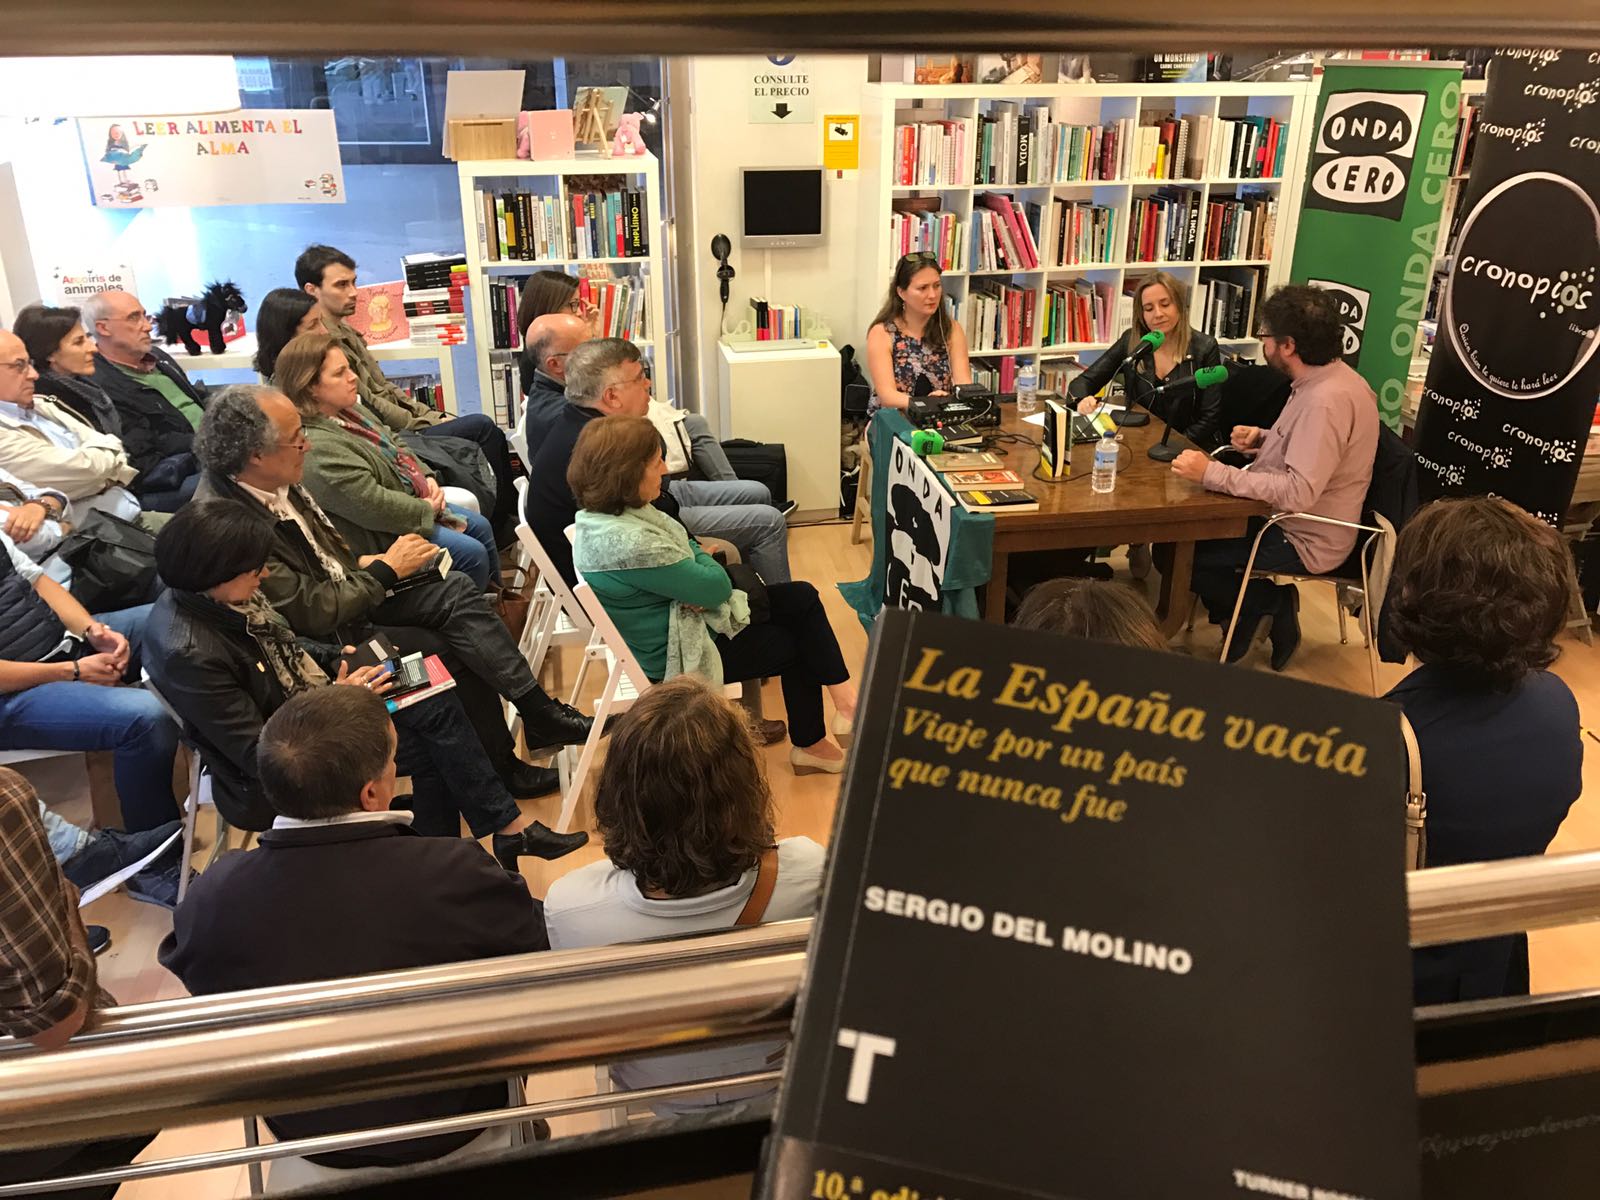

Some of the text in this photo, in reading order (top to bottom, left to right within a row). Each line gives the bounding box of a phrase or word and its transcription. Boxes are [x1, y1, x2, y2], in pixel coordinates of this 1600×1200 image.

[754, 75, 809, 84] CONSULTE
[754, 87, 810, 97] EL PRECIO
[1524, 82, 1599, 106] cronopios
[132, 119, 303, 136] LEER ALIMENTA EL
[1331, 116, 1403, 142] ONDA
[1421, 81, 1460, 205] CERO
[1480, 121, 1544, 144] cronopios
[197, 141, 250, 155] ALMA
[1018, 134, 1029, 167] MODA
[1326, 164, 1395, 195] CERO
[1188, 208, 1199, 245] EL INCAL
[64, 282, 124, 295] animales
[108, 274, 122, 282] de
[1390, 221, 1440, 356] ONDA
[1461, 256, 1593, 310] cronopios
[1459, 324, 1471, 353] Quien
[1521, 377, 1541, 390] hará
[1447, 431, 1512, 469] cronopios
[1502, 423, 1576, 463] cronopios
[895, 445, 944, 522] ONDA
[904, 646, 1368, 778] La España vacía
[900, 705, 1188, 789] Viaje por un país
[888, 754, 1128, 824] que nunca fue
[864, 884, 1193, 976] SERGIO DEL MOLINO
[837, 1027, 897, 1105] T
[1232, 1167, 1310, 1200] TURNER
